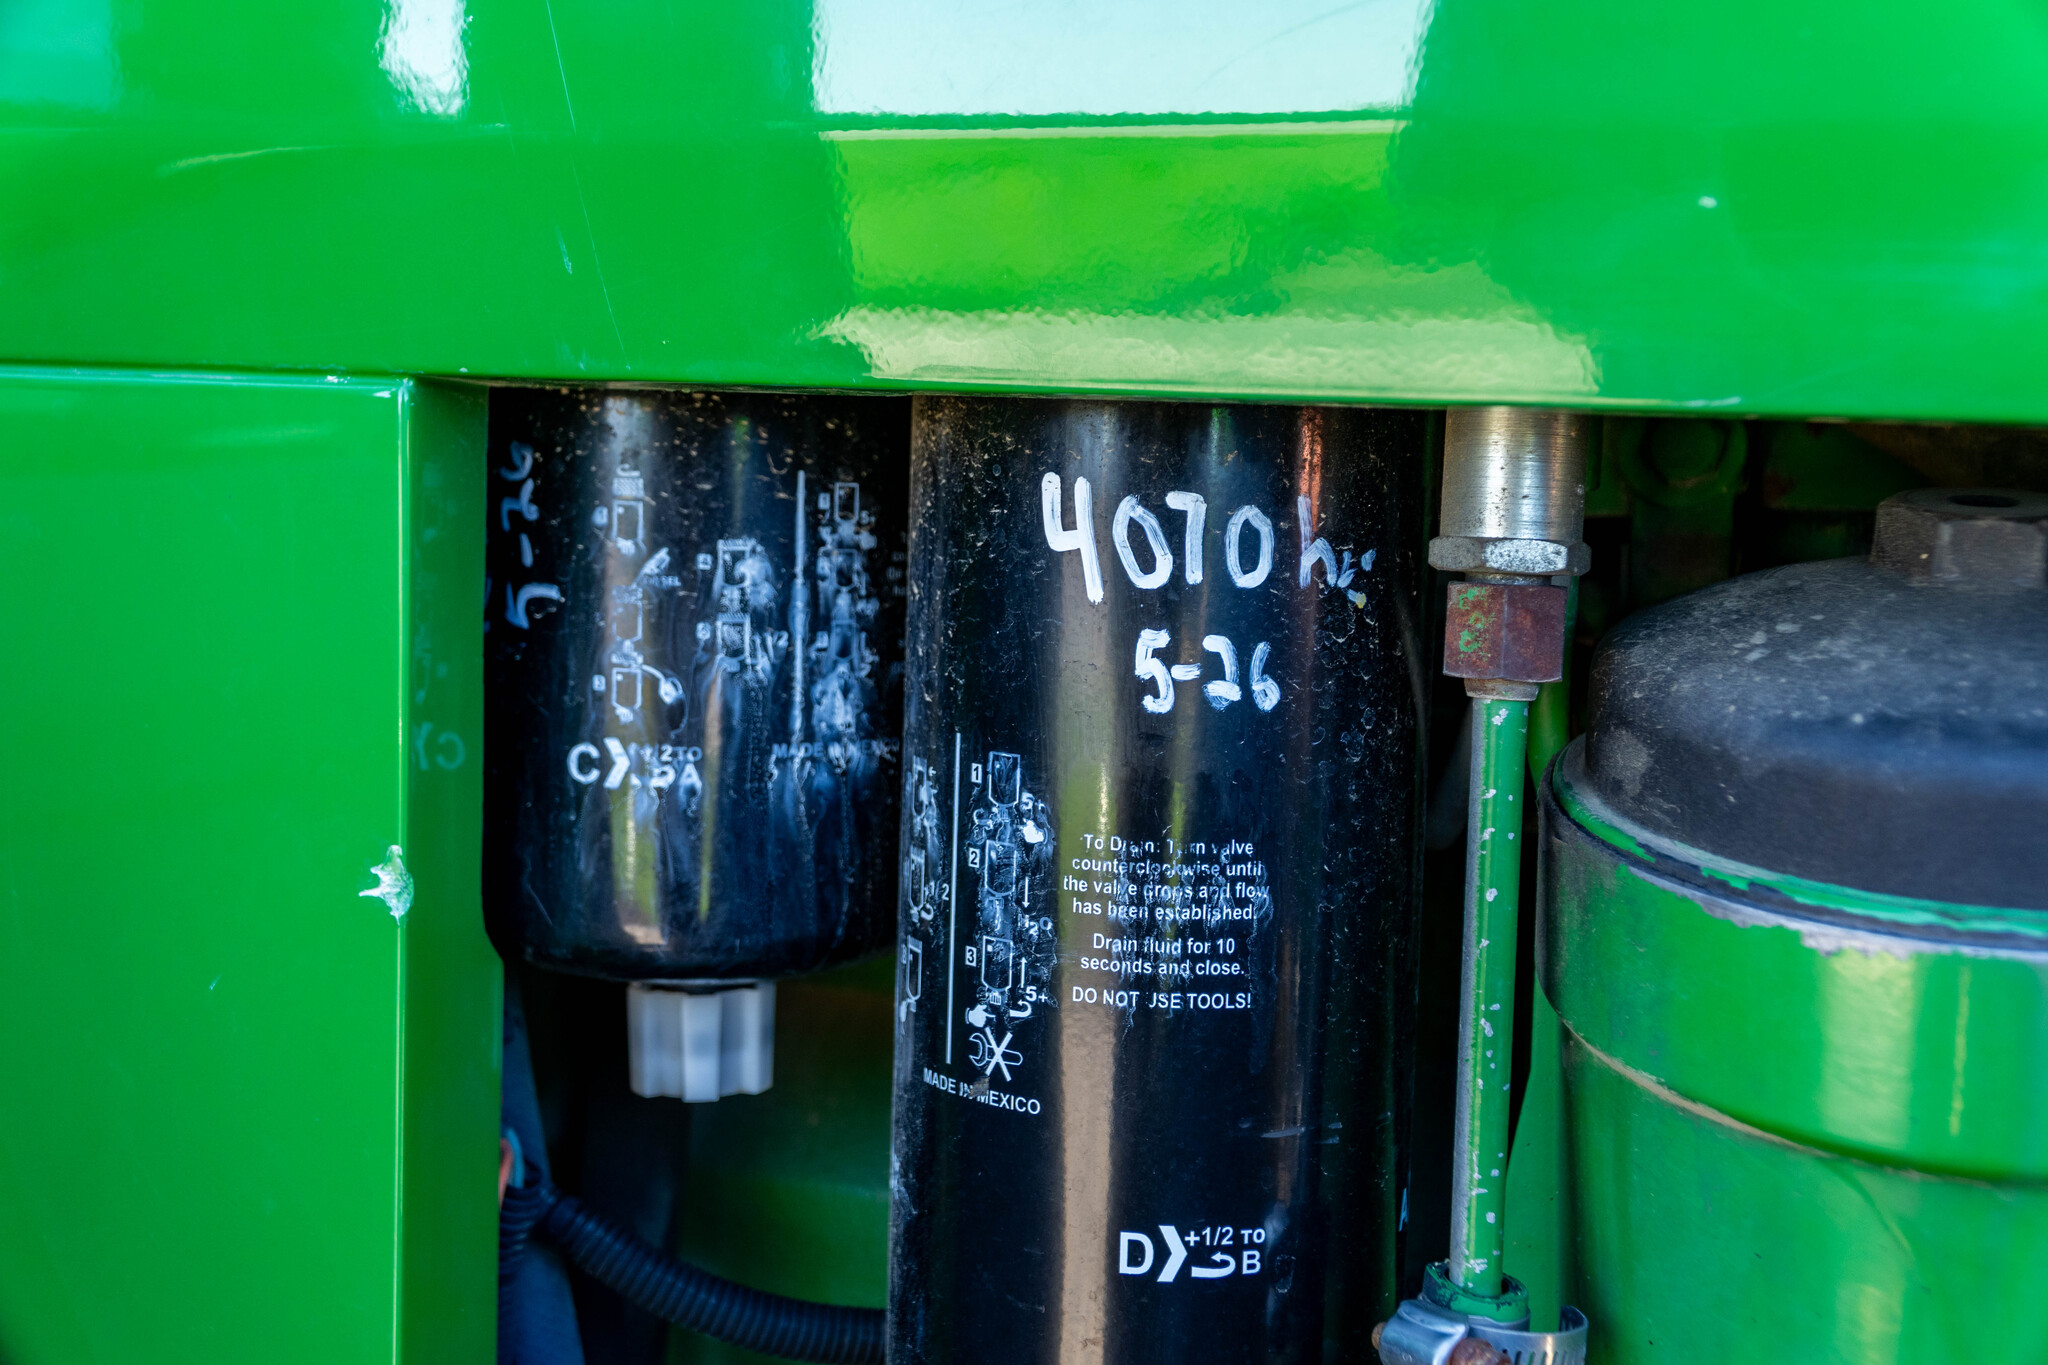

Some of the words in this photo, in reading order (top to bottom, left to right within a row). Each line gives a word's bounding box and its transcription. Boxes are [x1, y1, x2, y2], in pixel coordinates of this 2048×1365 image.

[1041, 471, 1275, 604] 4070
[1134, 628, 1282, 714] 5-26
[566, 741, 601, 784] C
[1083, 834, 1105, 851] To
[1072, 858, 1221, 877] counterclockwise
[1226, 860, 1261, 876] until
[1063, 875, 1088, 892] the
[1093, 879, 1138, 896] valve
[1143, 882, 1193, 900] drops
[1199, 882, 1230, 898] and
[1235, 881, 1270, 898] flow
[1072, 897, 1102, 915] has
[1107, 901, 1149, 918] been
[1155, 903, 1257, 920] established.
[1093, 932, 1138, 952] Drain
[1143, 936, 1182, 955] fluid
[1187, 937, 1211, 954] for
[1216, 938, 1236, 954] 10
[1080, 956, 1153, 974] seconds
[1158, 959, 1190, 976] and
[1195, 959, 1245, 975] close.
[1072, 986, 1098, 1004] DO
[1103, 989, 1140, 1007] NOT
[1186, 992, 1252, 1009] TOOLS!
[923, 1067, 957, 1095] MADE
[1119, 1231, 1155, 1276] D
[1184, 1226, 1234, 1247] +1/2
[1240, 1228, 1266, 1245] TO
[1242, 1250, 1261, 1275] B
